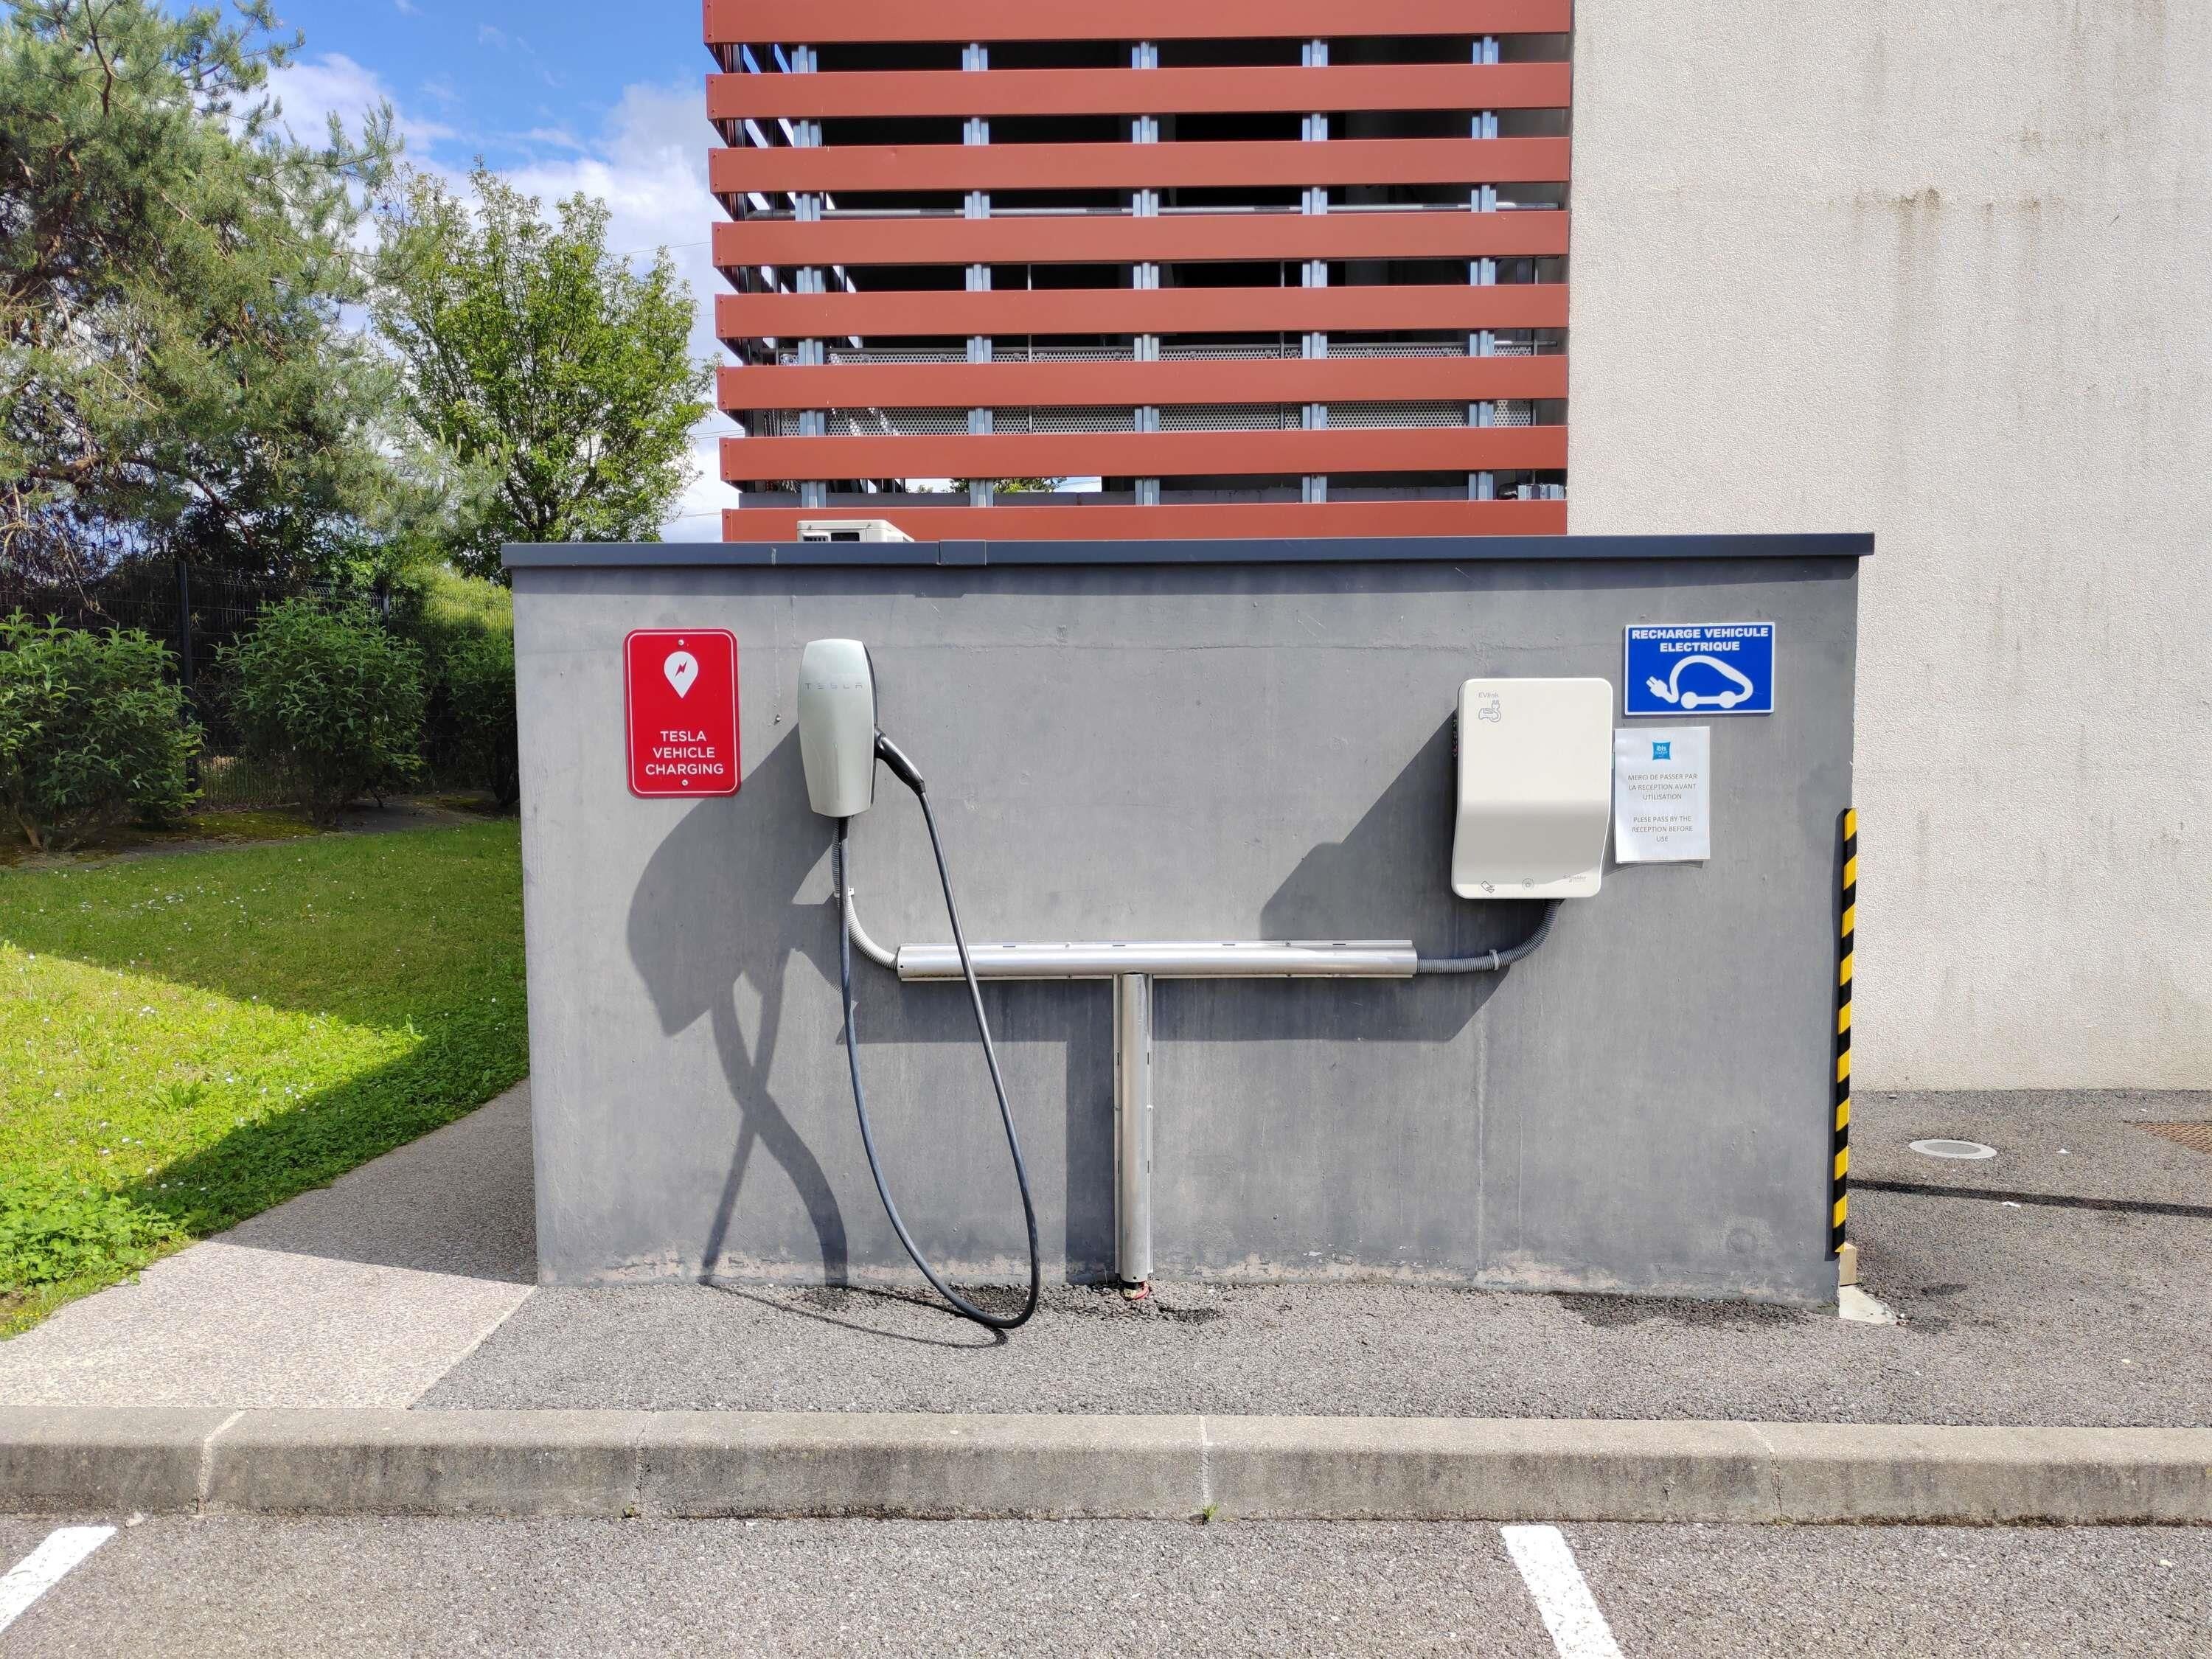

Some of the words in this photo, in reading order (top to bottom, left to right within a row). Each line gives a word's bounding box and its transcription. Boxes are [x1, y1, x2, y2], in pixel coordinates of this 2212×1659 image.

[1632, 629, 1700, 639] RECHARGE
[1704, 627, 1768, 638] VEHICULE
[1660, 641, 1739, 652] ELECTRIQUE
[804, 682, 863, 690] TESLA
[660, 731, 706, 742] TESLA
[653, 747, 715, 758] VEHICLE
[645, 763, 723, 775] CHARGING
